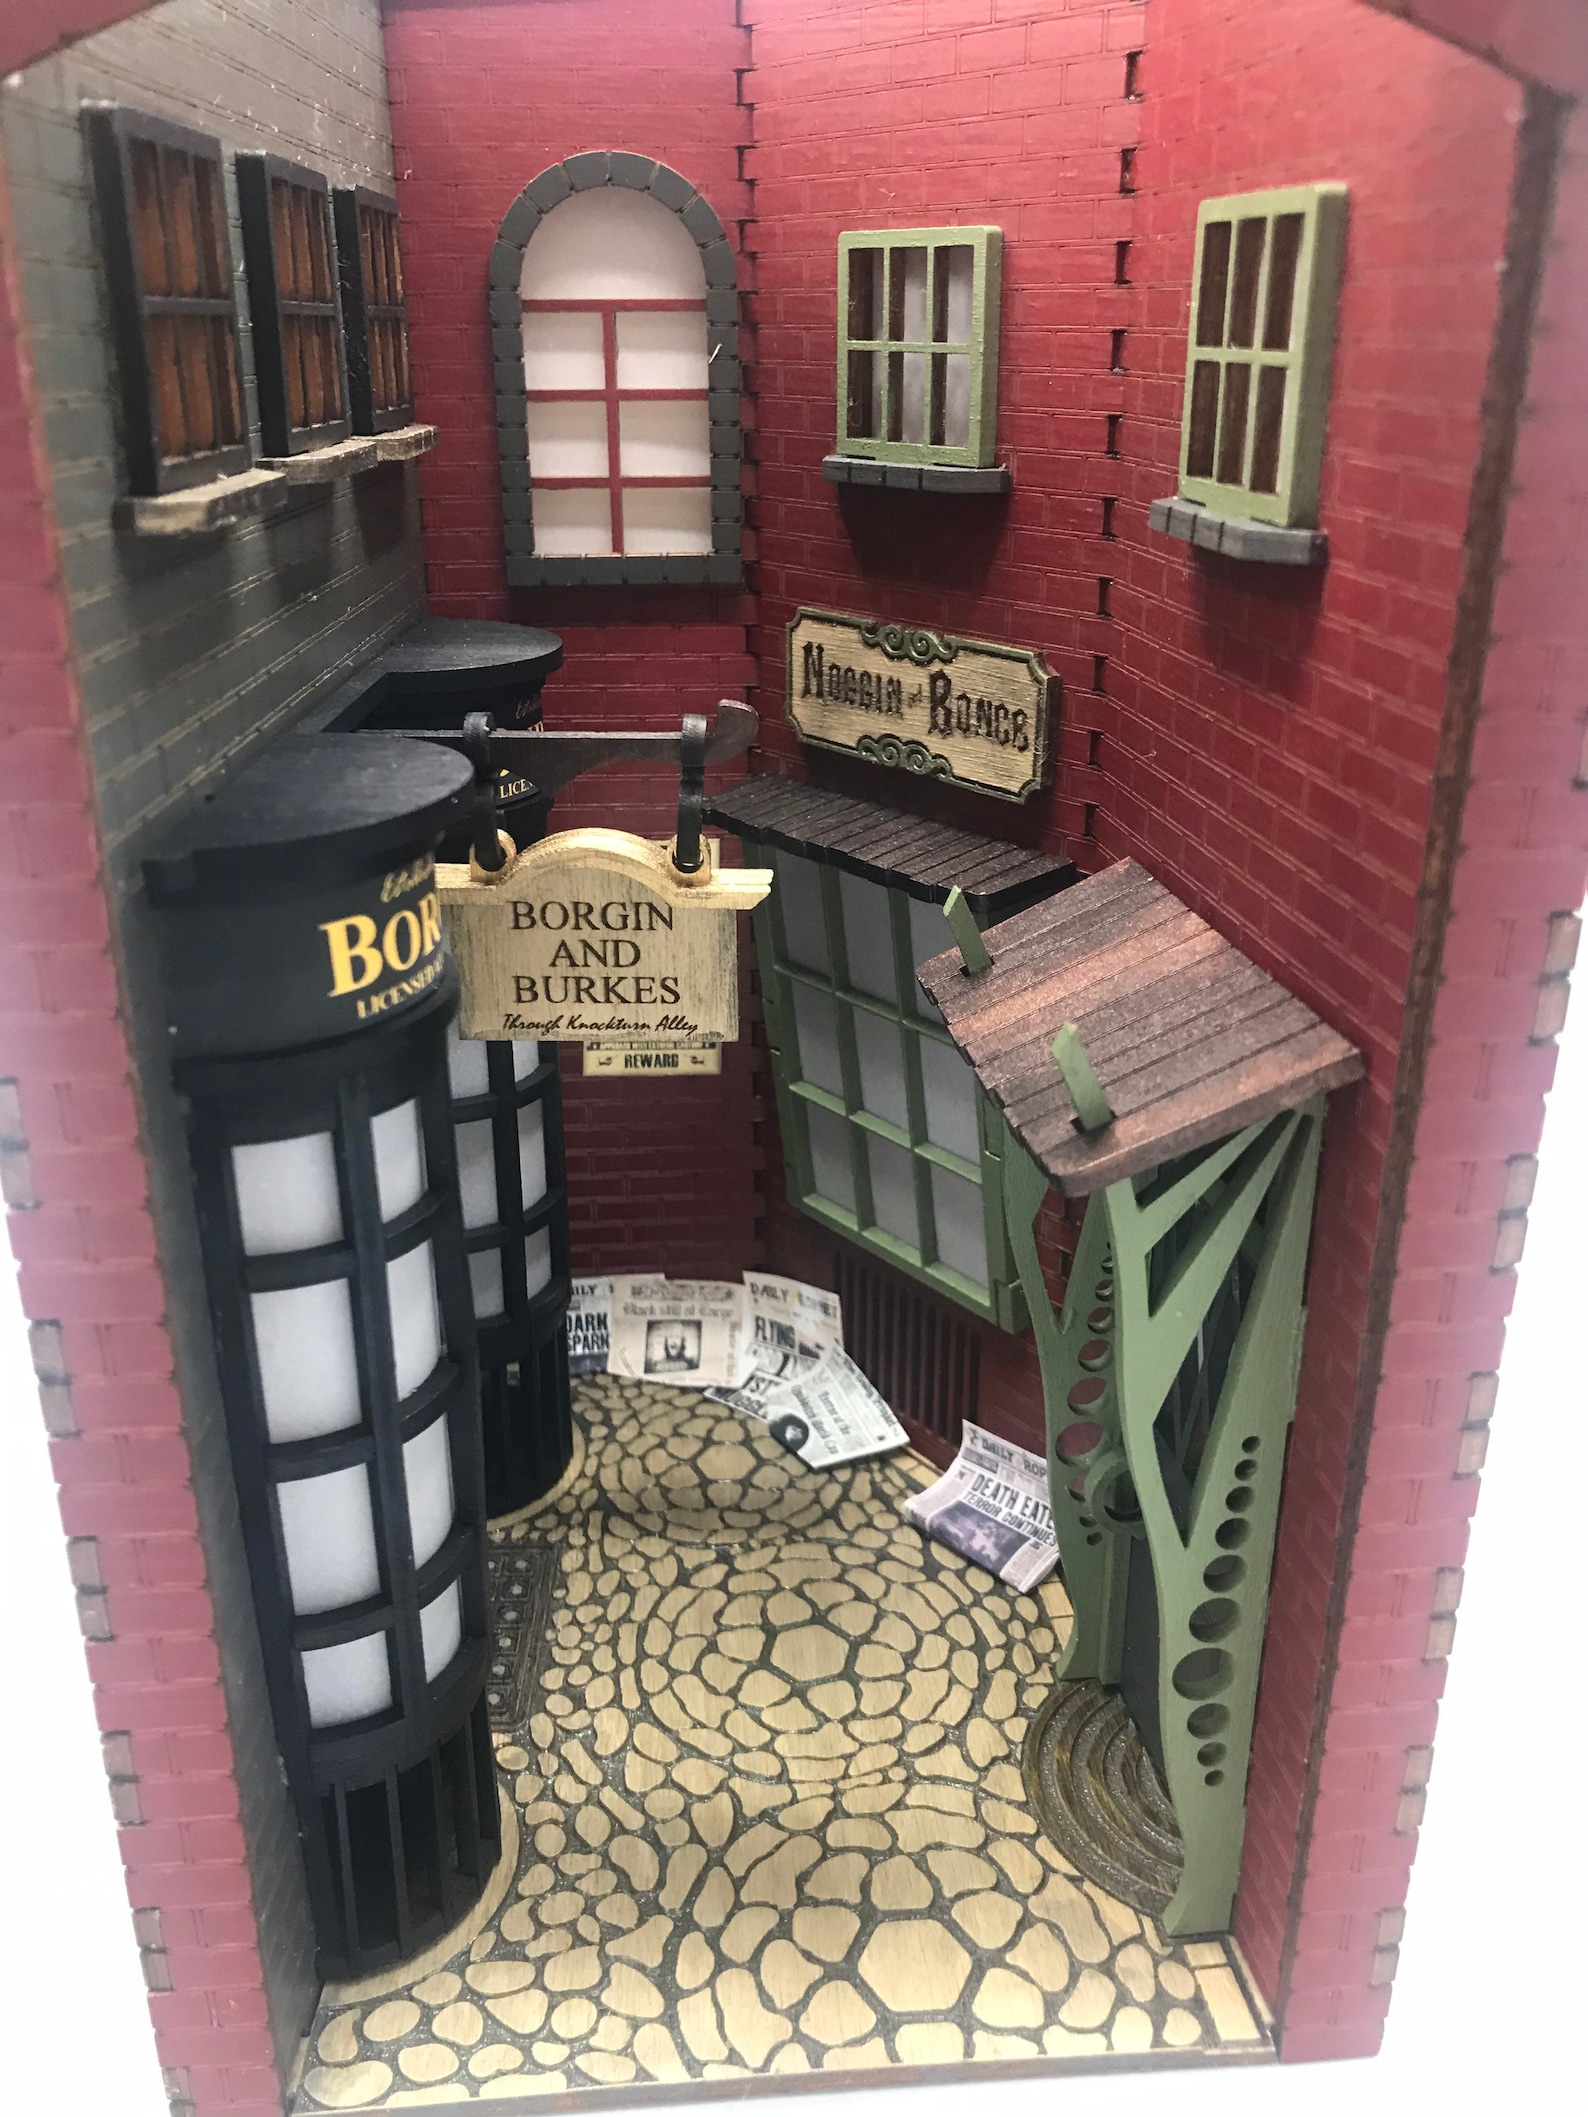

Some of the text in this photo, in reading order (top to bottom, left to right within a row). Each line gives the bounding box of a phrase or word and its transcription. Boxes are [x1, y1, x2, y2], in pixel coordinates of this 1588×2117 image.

[500, 778, 533, 799] LICE
[510, 900, 673, 931] BORGIN
[549, 939, 641, 968] AND
[513, 975, 681, 1005] BURKES
[502, 1013, 699, 1037] Through Knockturn Alley
[624, 1053, 679, 1069] REWARD
[981, 1437, 1014, 1463] DAILY
[971, 1474, 1019, 1510] DEATH
[961, 1491, 1002, 1519] TERROR
[1002, 1511, 1057, 1547] CONTINUES
